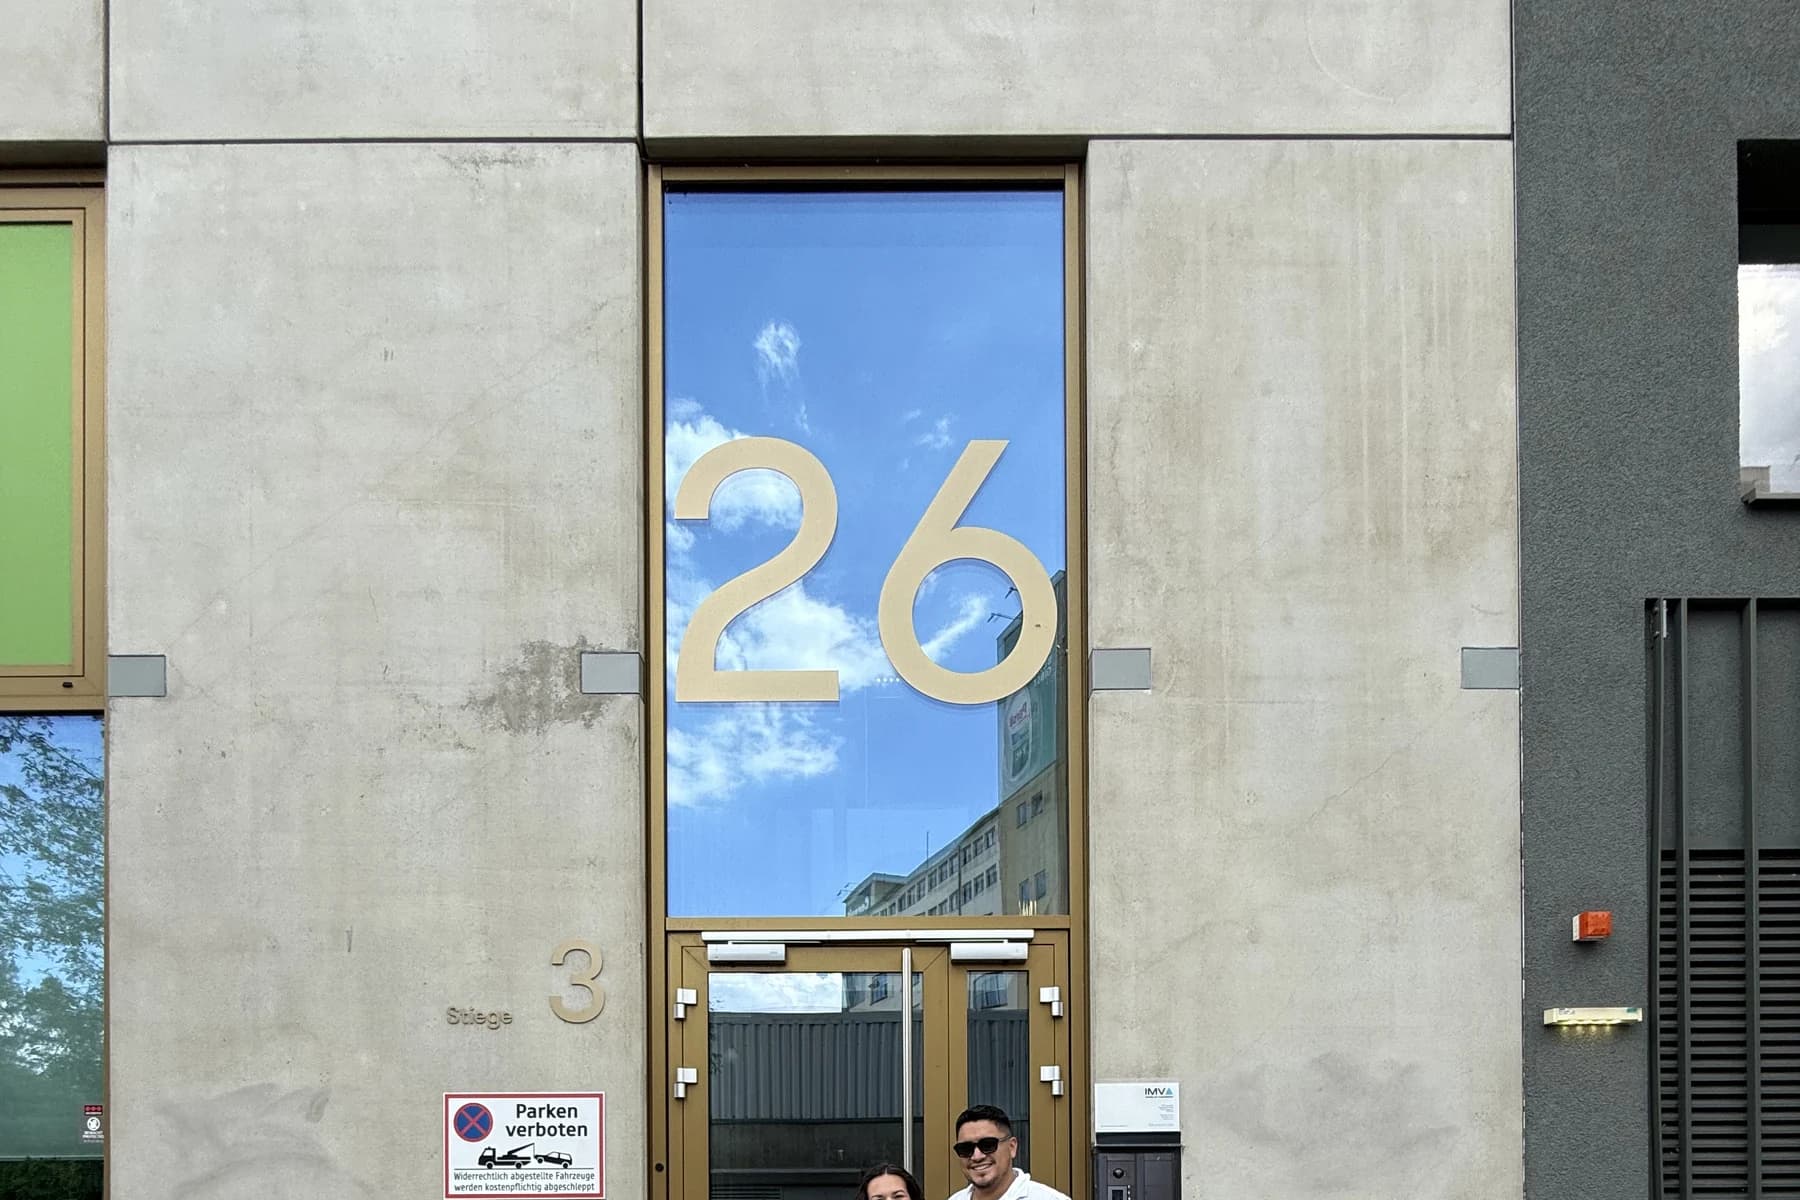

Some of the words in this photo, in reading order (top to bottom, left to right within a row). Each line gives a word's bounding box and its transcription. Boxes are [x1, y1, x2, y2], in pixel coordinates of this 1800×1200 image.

[674, 436, 1058, 704] 26
[446, 1006, 513, 1030] Stiege
[549, 938, 605, 1025] 3
[516, 1104, 578, 1119] Parken
[505, 1122, 588, 1137] verboten
[454, 1171, 508, 1180] Widerrechtlich
[510, 1171, 554, 1182] abgestellte
[555, 1171, 595, 1182] Fahrzeuge
[454, 1182, 483, 1191] werden
[485, 1182, 542, 1193] kostenpflichtig
[543, 1182, 595, 1192] abgeschleppt
